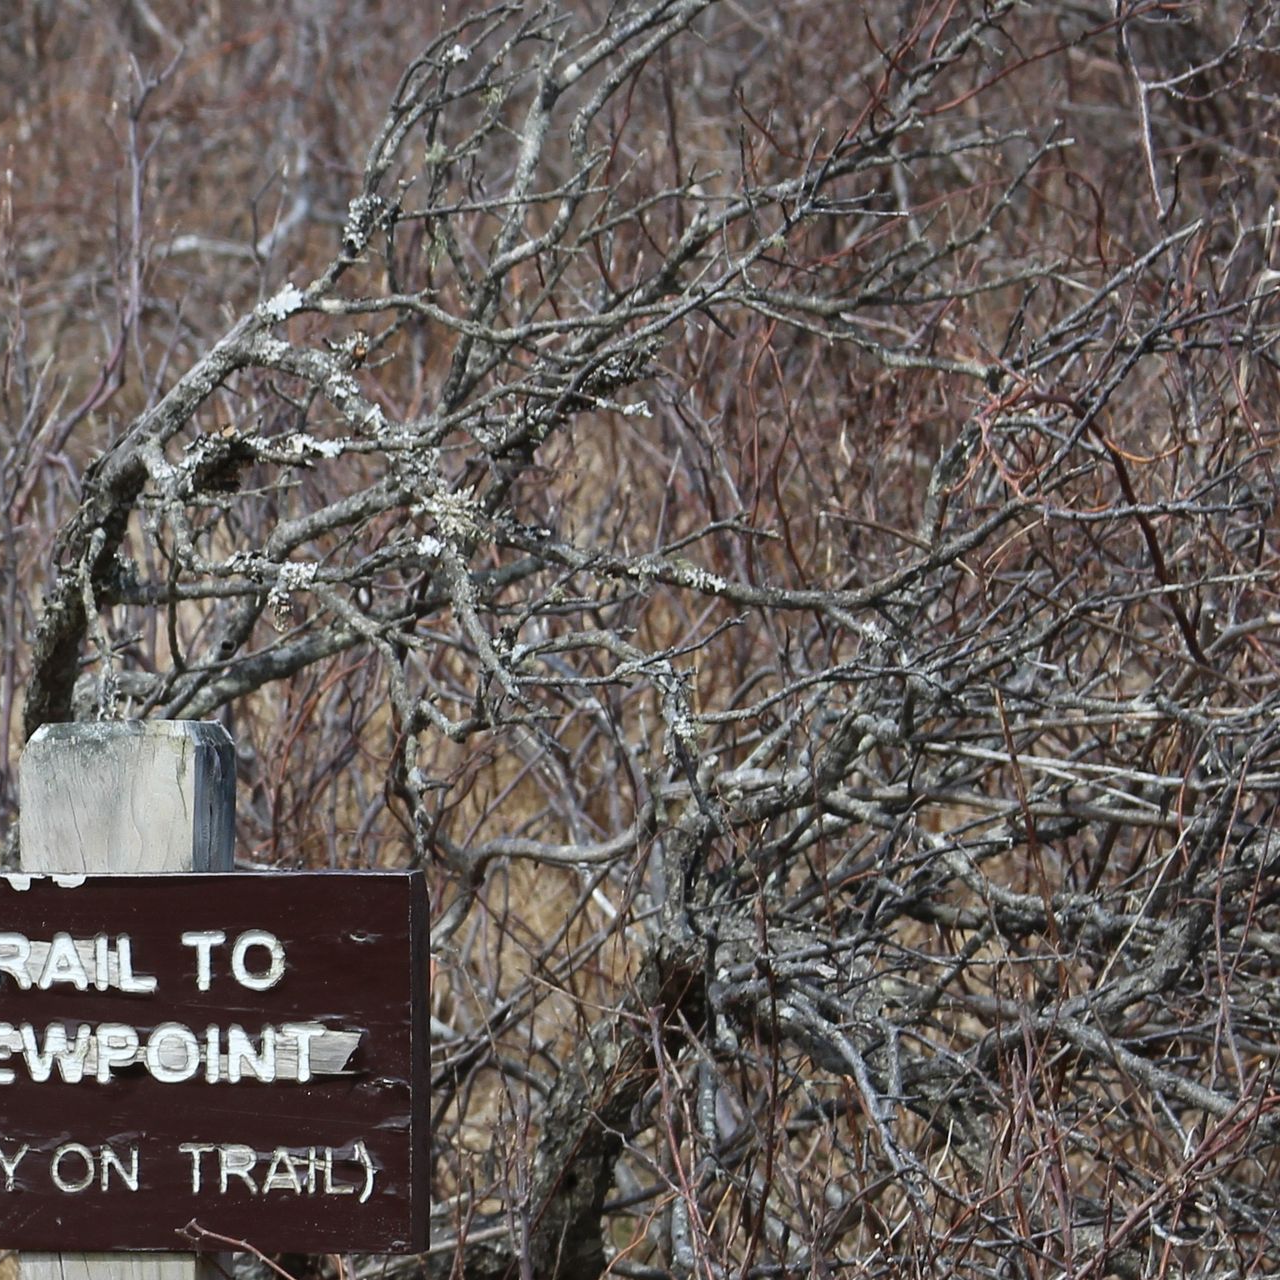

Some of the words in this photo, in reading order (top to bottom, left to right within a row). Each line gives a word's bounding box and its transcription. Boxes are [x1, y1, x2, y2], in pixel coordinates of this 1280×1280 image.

[181, 929, 286, 992] TO
[51, 1143, 140, 1194] ON
[179, 1142, 378, 1204] TRAIL)
